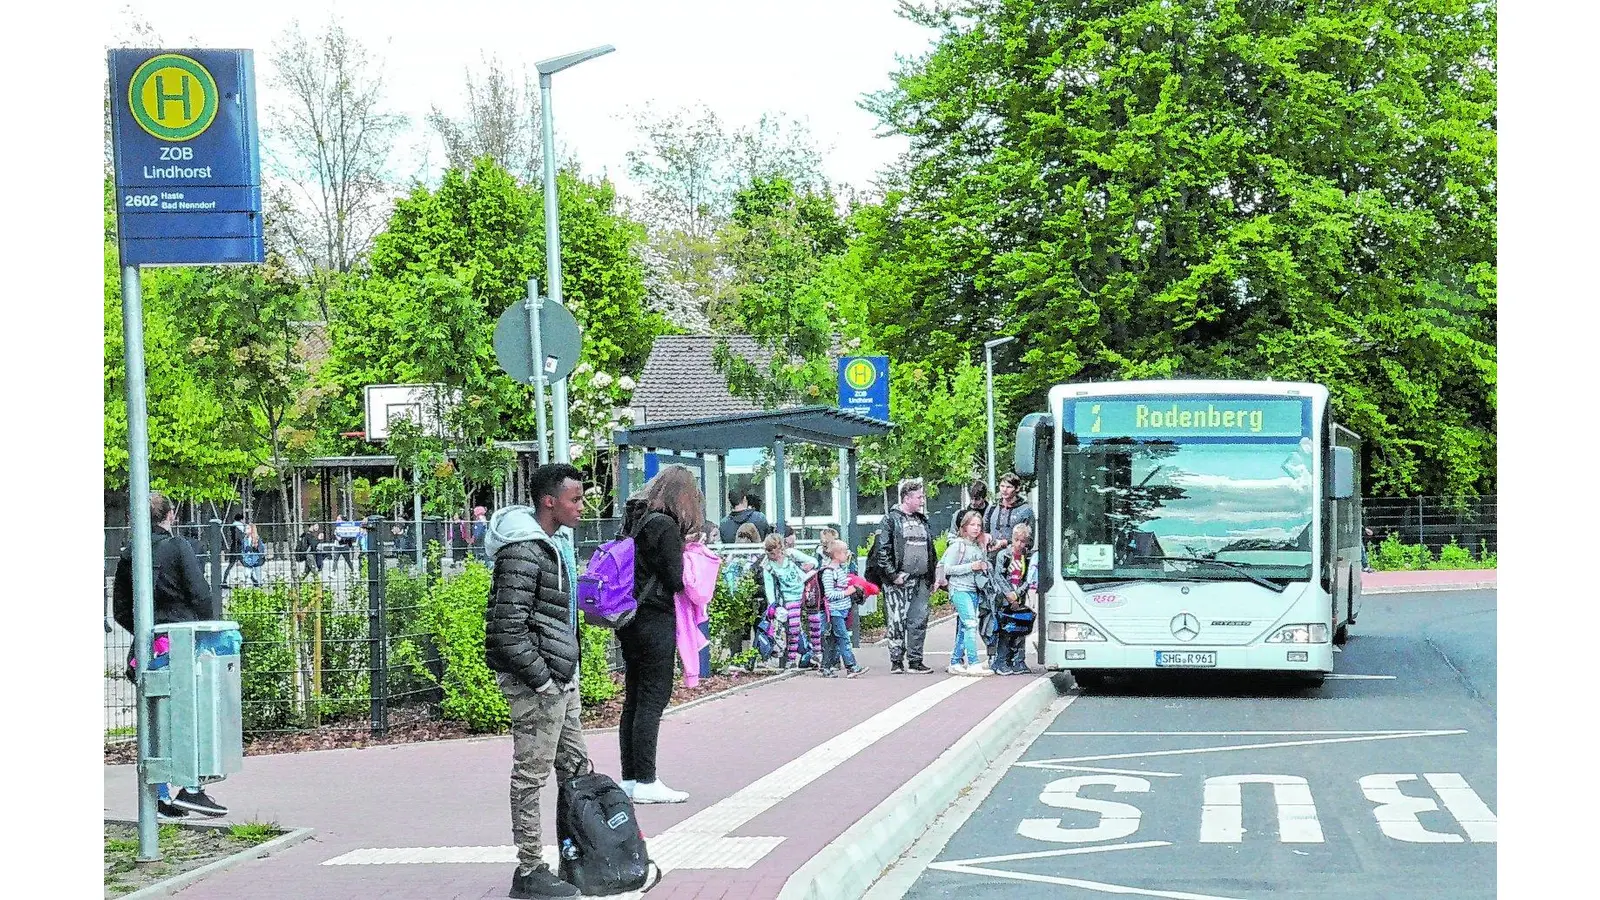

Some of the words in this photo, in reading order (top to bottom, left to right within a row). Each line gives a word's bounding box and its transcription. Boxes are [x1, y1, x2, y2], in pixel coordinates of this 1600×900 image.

[155, 76, 192, 120] H
[159, 147, 194, 160] ZOB
[143, 165, 212, 178] Lindhorst
[125, 195, 158, 207] 2602
[161, 192, 184, 200] Haste
[161, 201, 177, 209] Bad
[179, 201, 216, 209] Nenndorf
[854, 366, 867, 382] H
[1135, 404, 1263, 432] Rodenberg
[1162, 654, 1181, 663] SHG
[1187, 654, 1194, 663] R
[1195, 654, 1213, 663] 961
